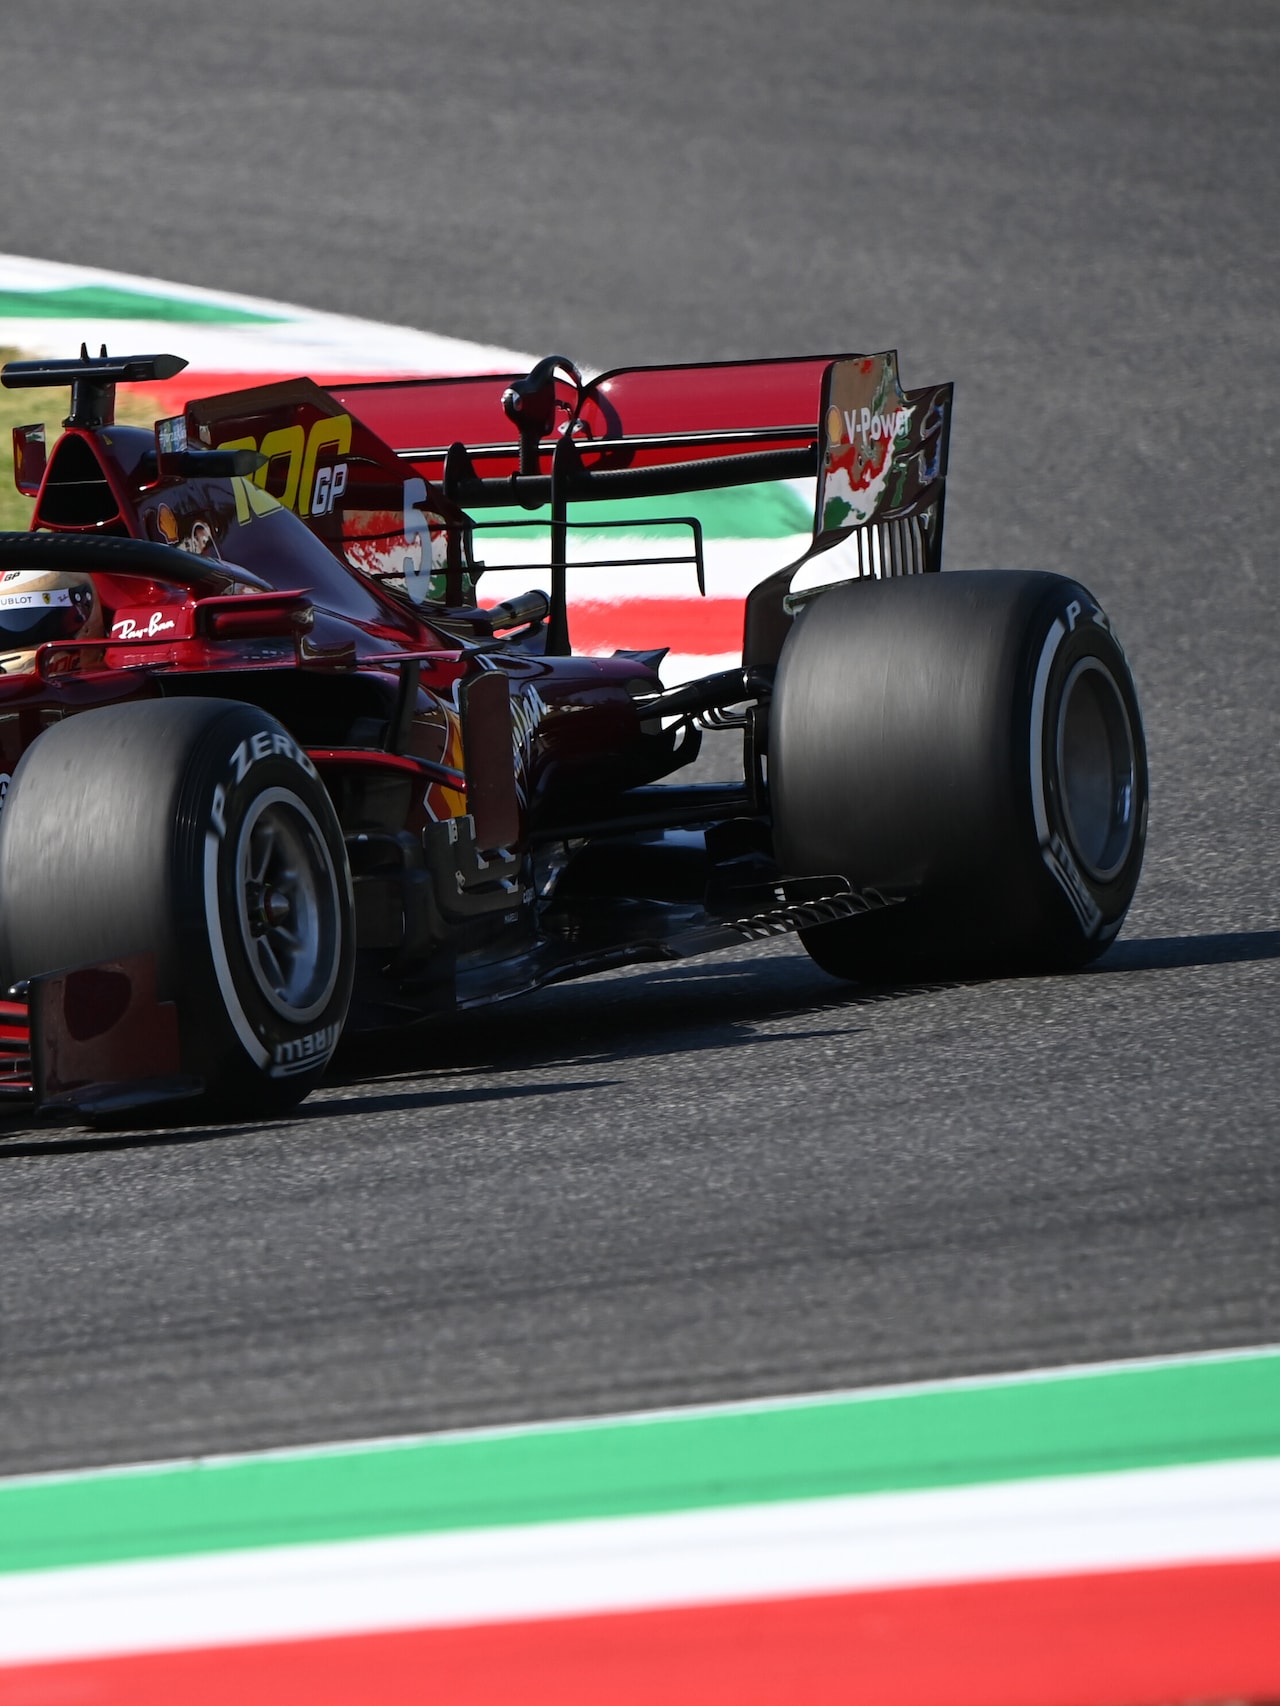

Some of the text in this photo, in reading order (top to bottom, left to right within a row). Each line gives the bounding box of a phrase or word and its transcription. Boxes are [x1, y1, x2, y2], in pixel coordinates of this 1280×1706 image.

[844, 407, 911, 445] V-Power
[311, 463, 348, 517] GP
[112, 611, 175, 639] Ray-Ban
[229, 730, 318, 786] ZERO
